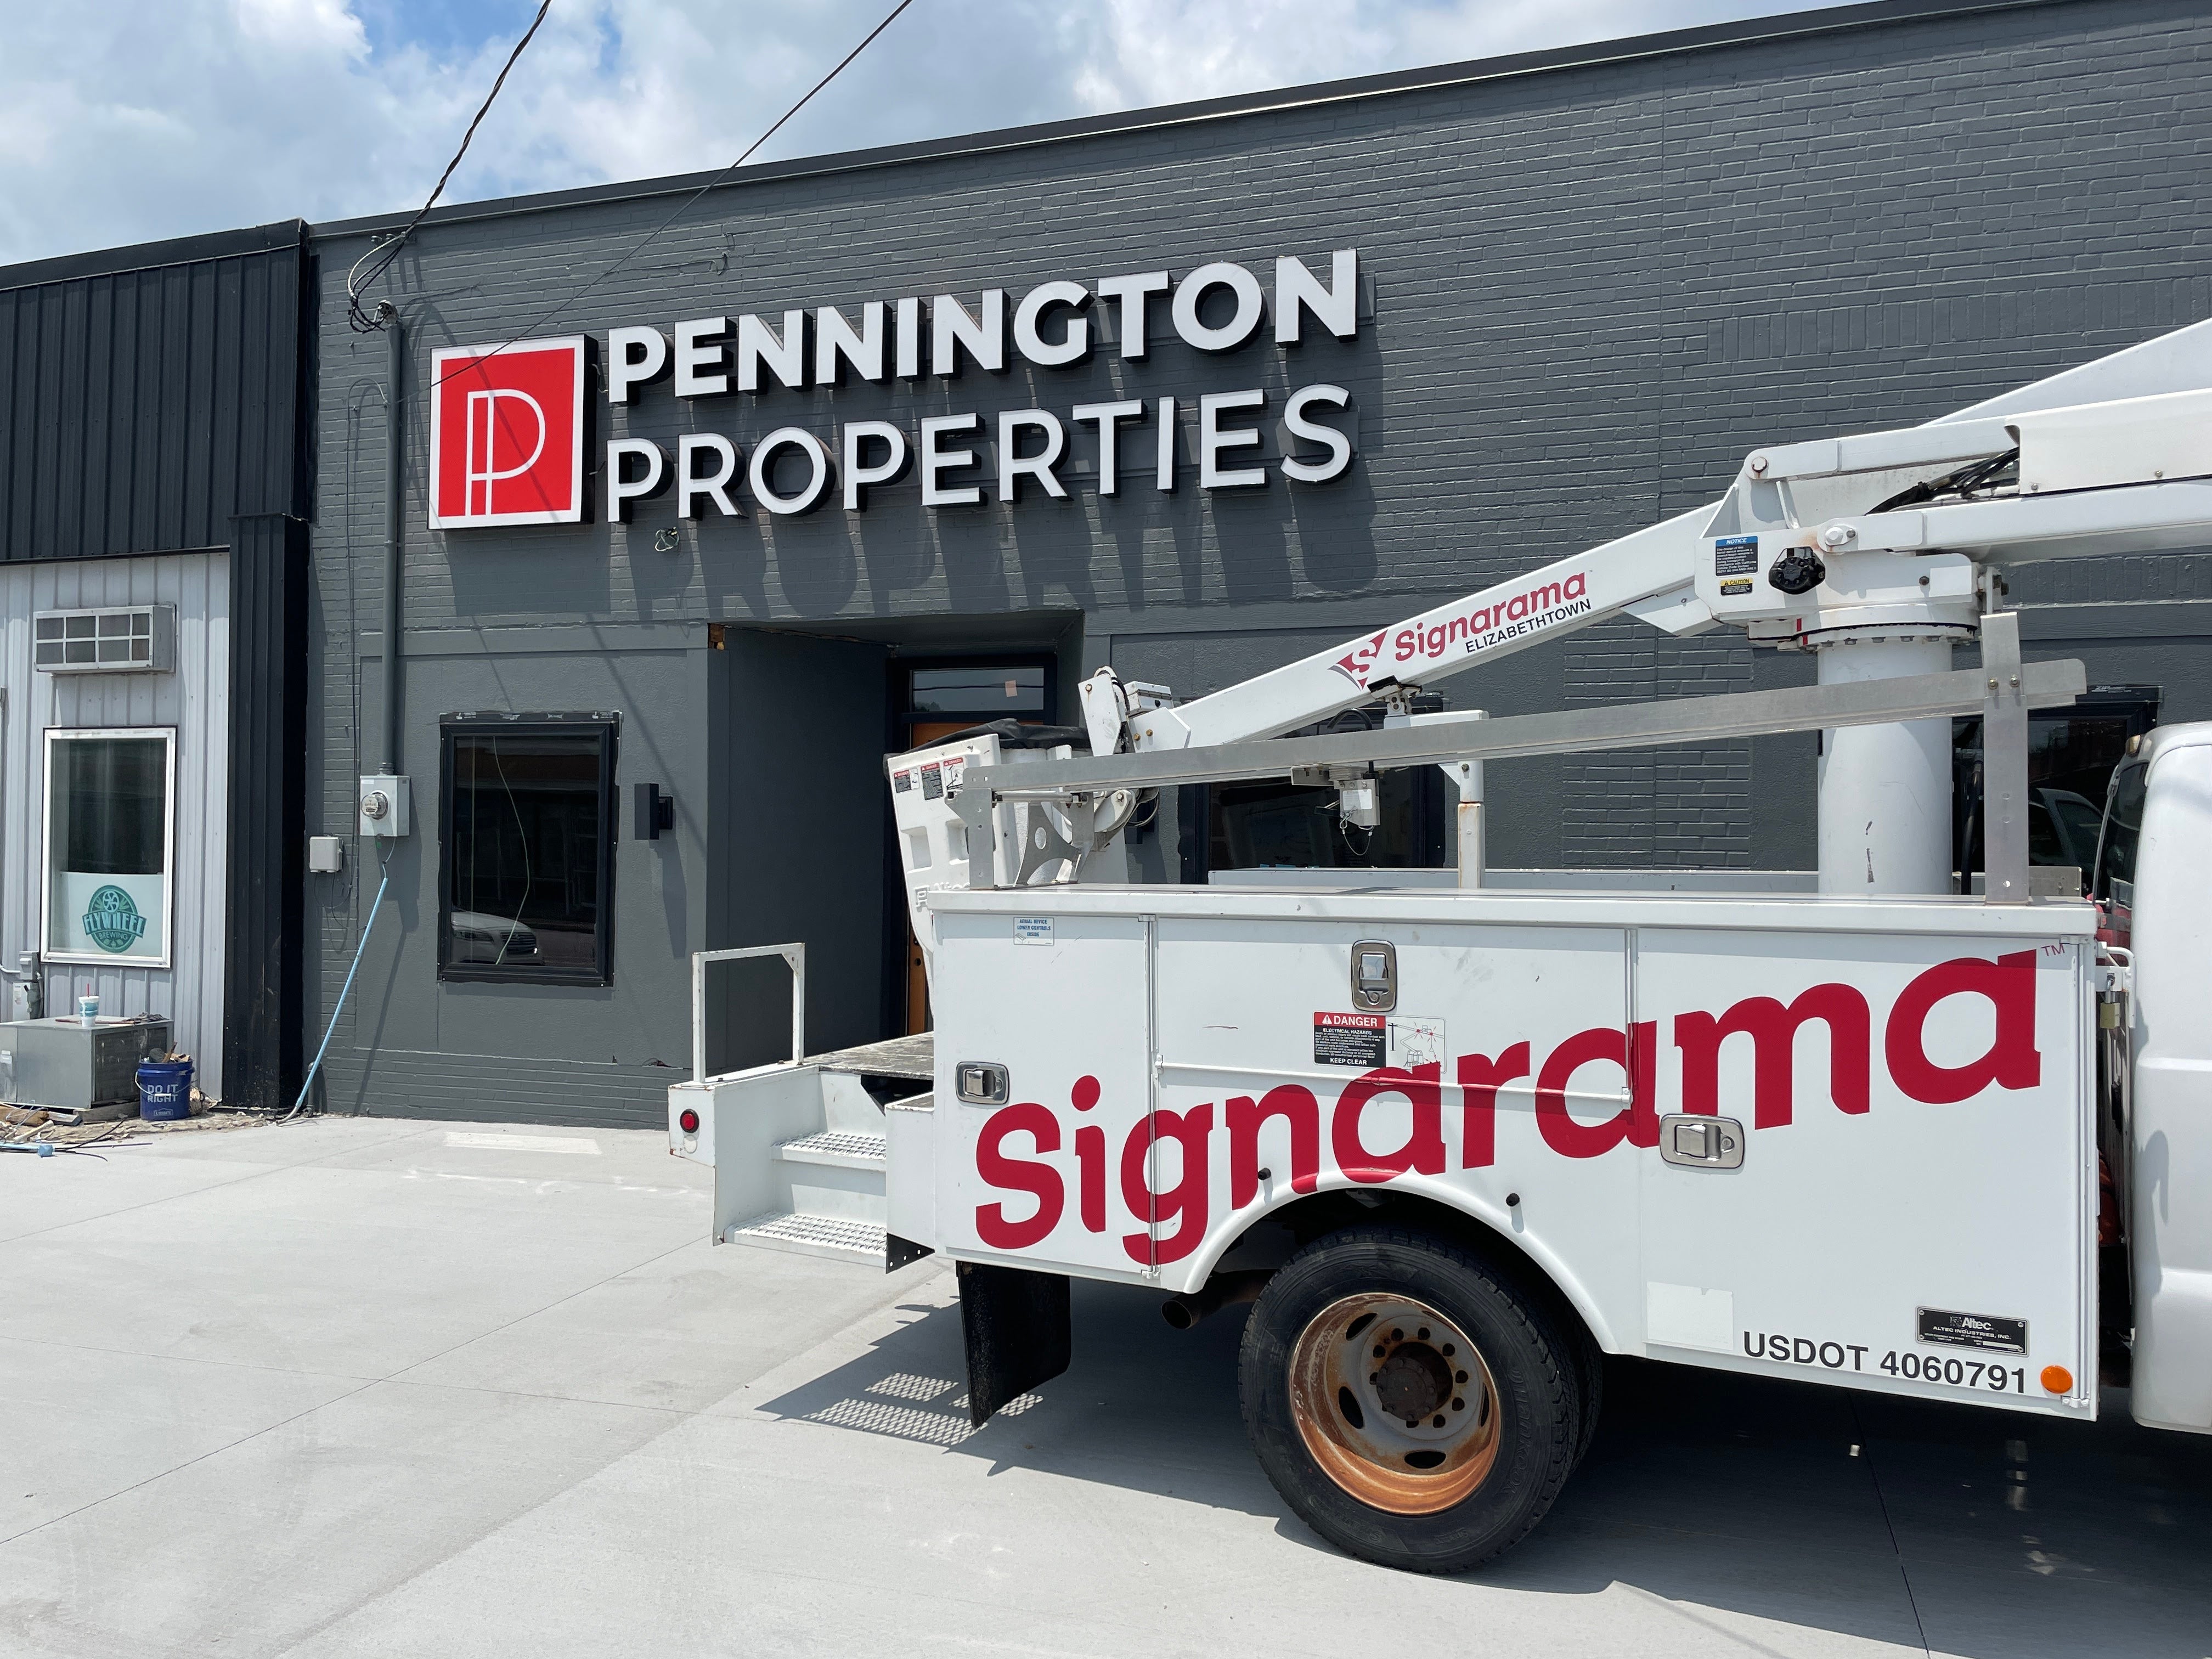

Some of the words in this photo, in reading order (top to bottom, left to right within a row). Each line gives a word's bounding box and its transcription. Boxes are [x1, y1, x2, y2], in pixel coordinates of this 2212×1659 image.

[608, 249, 1356, 403] PENNINGTON
[607, 385, 1350, 522] PROPERTIES
[1395, 572, 1586, 662] Signarama
[1465, 598, 1591, 653] ELIZABETHTOWN
[99, 931, 128, 940] BREWING
[1334, 1015, 1378, 1027] DANGER
[147, 1084, 163, 1093] DO
[167, 1084, 178, 1093] IT
[147, 1094, 178, 1103] RIGHT
[975, 947, 2041, 1265] Signarama
[2040, 943, 2066, 957] TM
[1955, 1328, 1997, 1339] INDUSTRIES,
[1961, 1317, 1991, 1330] Altec
[1744, 1331, 1869, 1371] USDOT
[1880, 1351, 2024, 1393] 4060791
